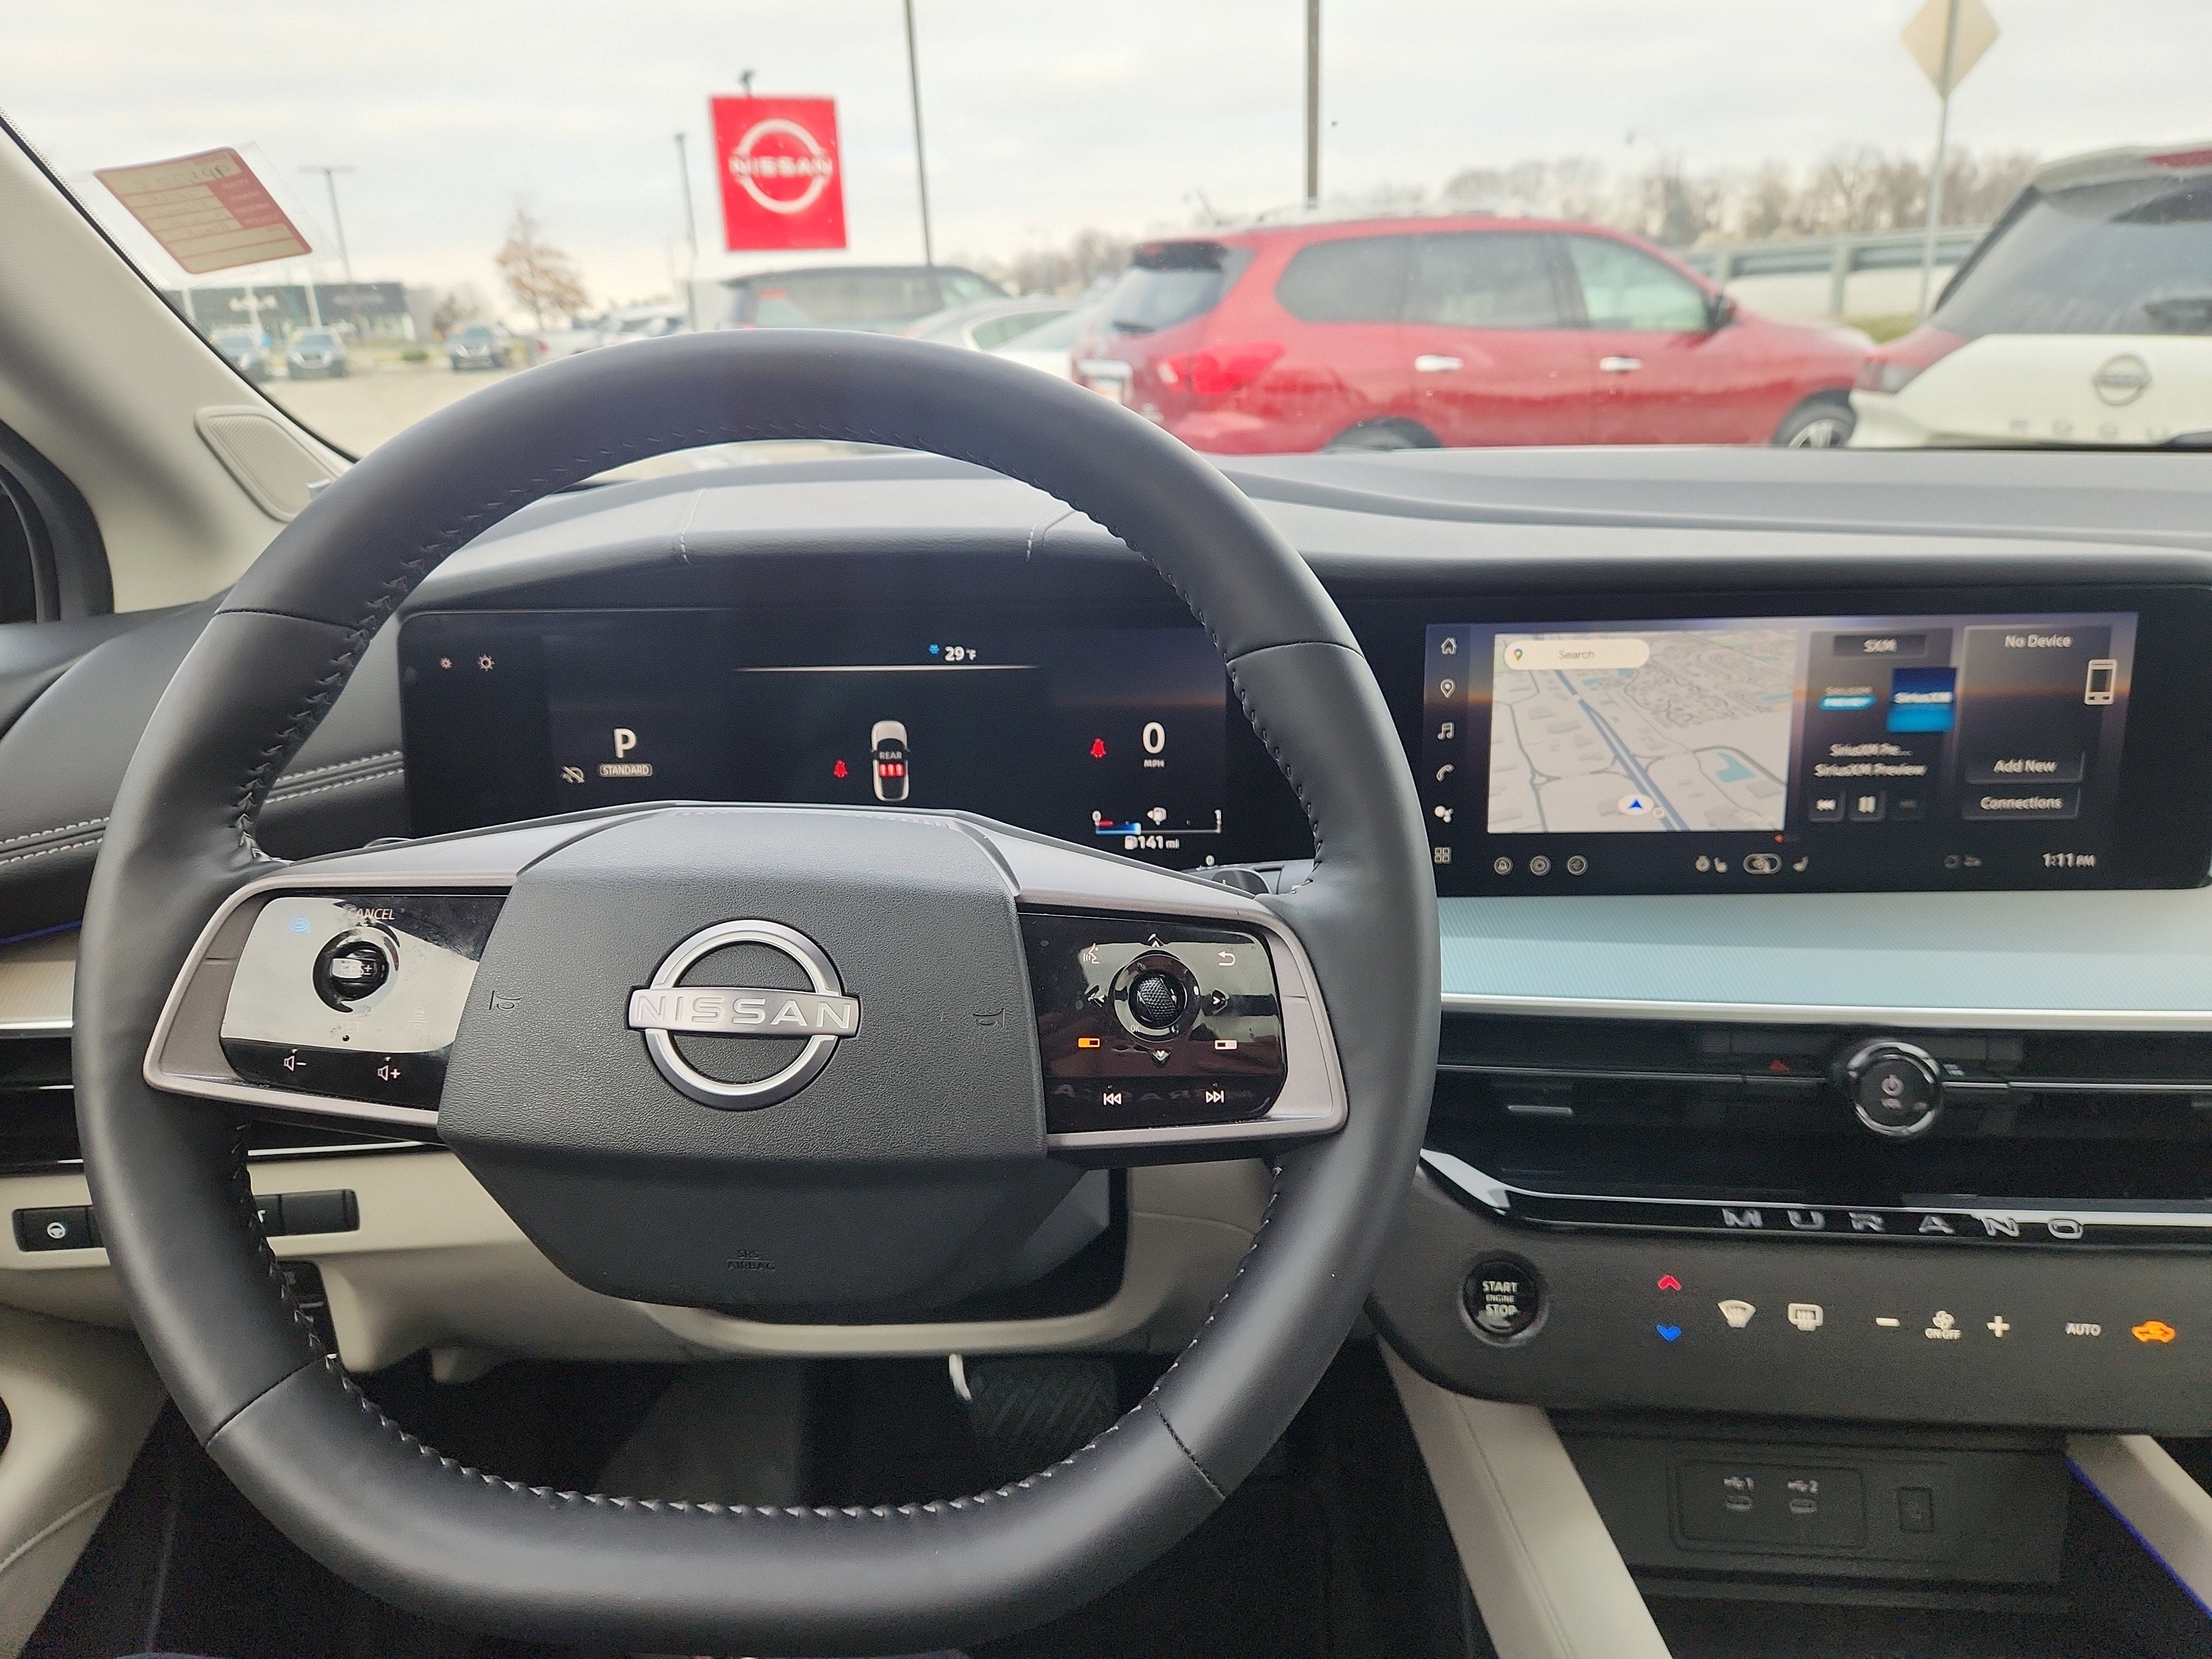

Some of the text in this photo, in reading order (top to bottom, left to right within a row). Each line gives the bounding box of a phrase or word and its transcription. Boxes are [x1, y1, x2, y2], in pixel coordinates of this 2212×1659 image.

[2005, 634, 2072, 648] No Device
[944, 646, 964, 661] 29
[1559, 650, 1595, 659] Search
[614, 728, 636, 758] P
[1143, 722, 1165, 754] 0
[601, 764, 649, 776] STANDARD
[1994, 759, 2057, 773] Add New
[1980, 796, 2062, 810] Connections
[1138, 835, 1163, 850] 141
[2043, 853, 2075, 867] 1:11
[348, 908, 395, 920] CANCEL
[635, 995, 852, 1030] NISSAN
[1130, 1024, 1140, 1032] OK
[1722, 1208, 2085, 1240] MURANO
[1482, 1281, 1517, 1293] START
[1486, 1304, 1518, 1317] STOP
[2066, 1322, 2101, 1336] AUTO
